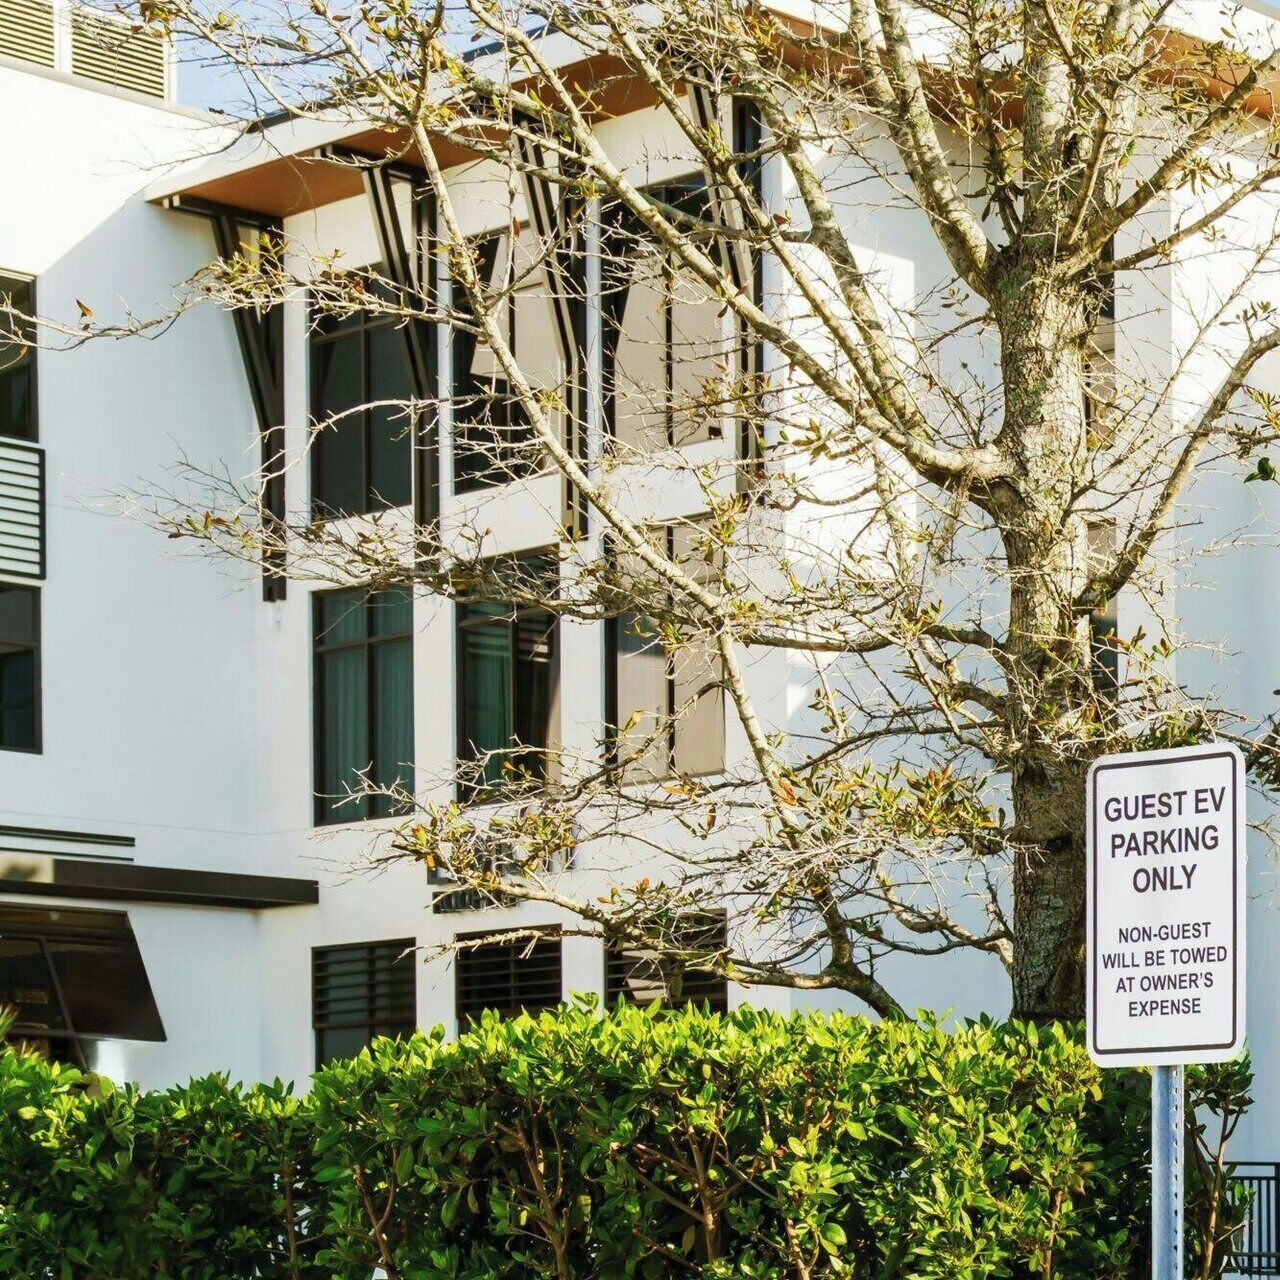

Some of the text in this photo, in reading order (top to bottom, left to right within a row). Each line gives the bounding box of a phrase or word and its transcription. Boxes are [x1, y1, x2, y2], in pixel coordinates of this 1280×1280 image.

[1104, 786, 1225, 822] GUEST EV
[1111, 824, 1218, 858] PARKING
[1132, 863, 1197, 893] ONLY
[1118, 921, 1211, 943] NON-GUEST
[1101, 945, 1227, 969] WILL BE TOWED
[1115, 971, 1213, 993] AT OWNER’S
[1128, 997, 1201, 1017] EXPENSE
